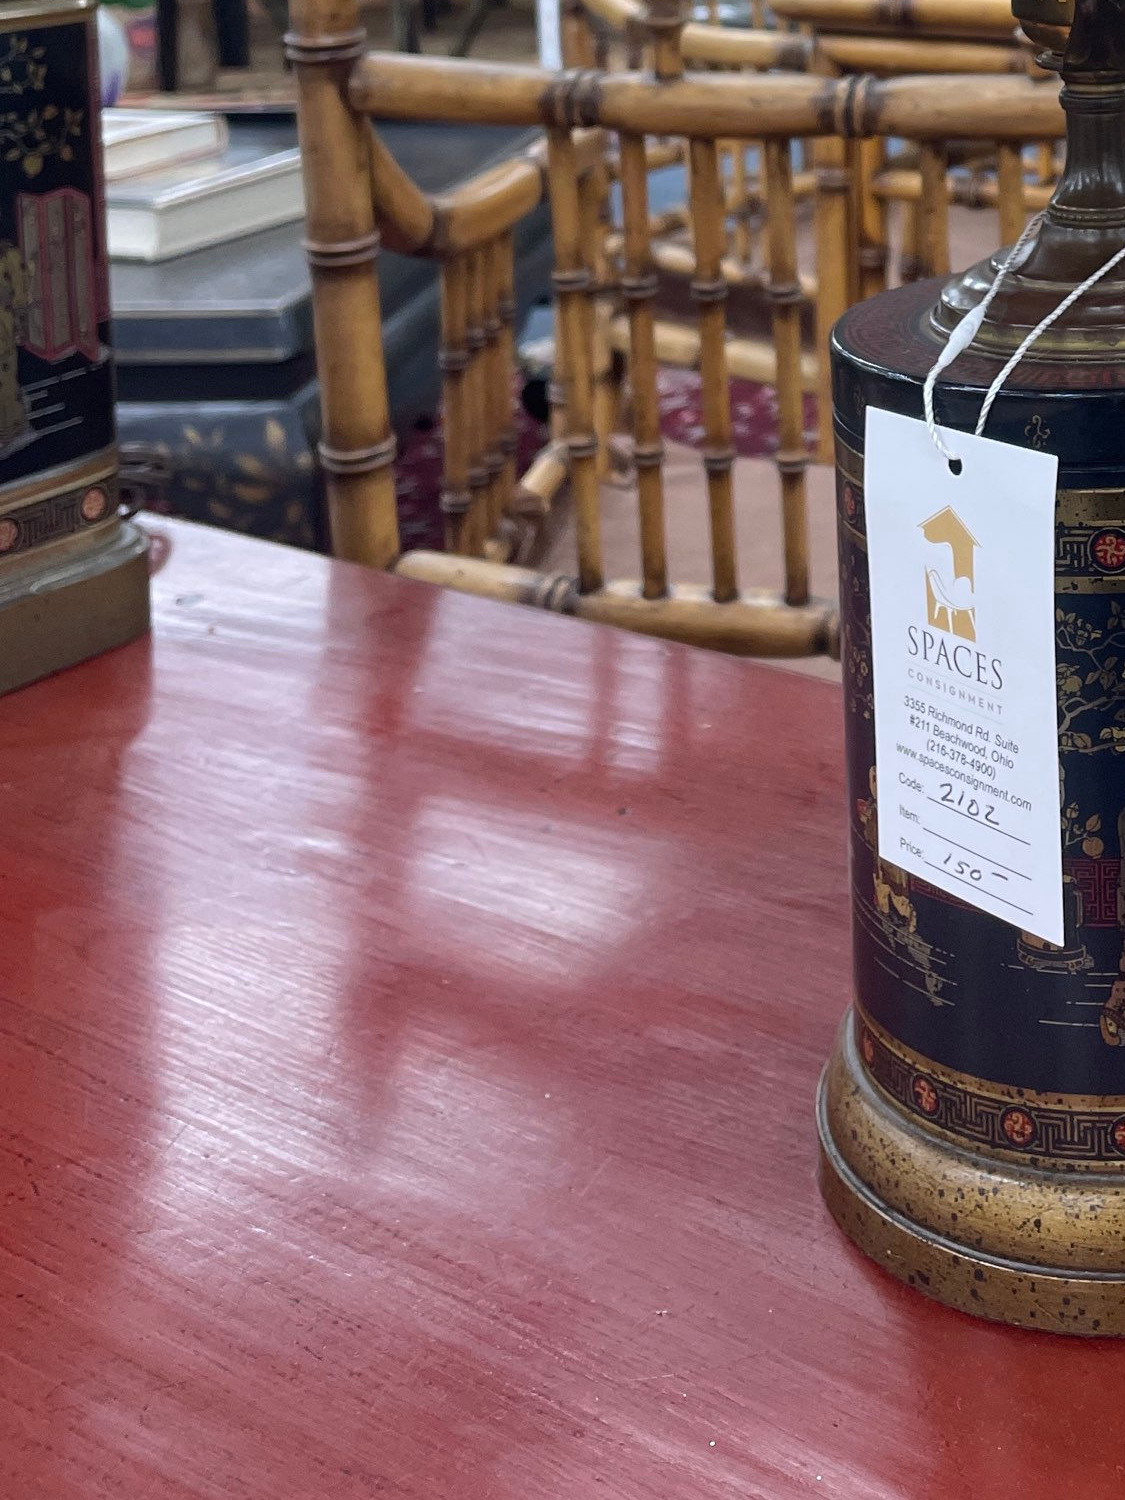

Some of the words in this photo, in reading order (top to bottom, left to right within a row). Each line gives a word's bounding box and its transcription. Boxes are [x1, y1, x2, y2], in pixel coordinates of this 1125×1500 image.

[907, 625, 1003, 690] SPACES
[907, 668, 1003, 715] CONSIGNMENT
[903, 695, 926, 714] 3355
[927, 706, 973, 735] Richmond
[975, 726, 991, 743] Rd.
[995, 734, 1019, 754] Suite
[909, 714, 930, 733] #211
[933, 724, 988, 760] Beachwood,
[991, 750, 1014, 769] Ohio
[896, 743, 1032, 811] www.spacesconsignment.com
[898, 772, 925, 794] Code:
[939, 783, 1000, 826] 2102
[898, 804, 921, 825] Item:
[899, 837, 925, 860] Price:
